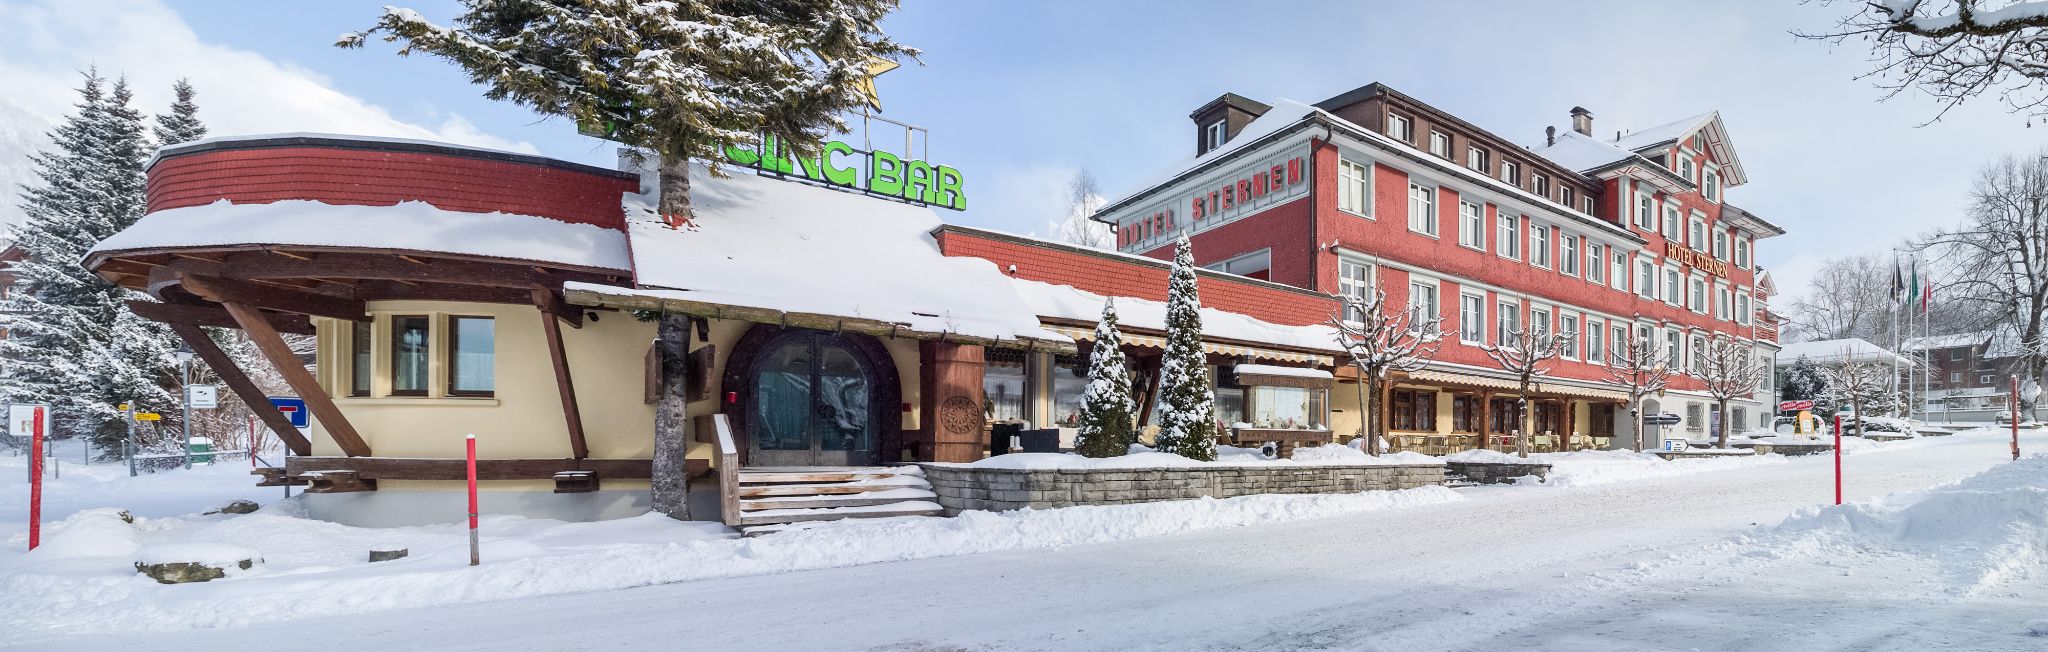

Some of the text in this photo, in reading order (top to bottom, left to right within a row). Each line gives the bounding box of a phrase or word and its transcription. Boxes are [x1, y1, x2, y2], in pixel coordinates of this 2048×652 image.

[869, 149, 967, 210] BAR
[1118, 156, 1304, 249] HOTEL STERNEN
[1668, 242, 1728, 278] HOTEL STERNEN
